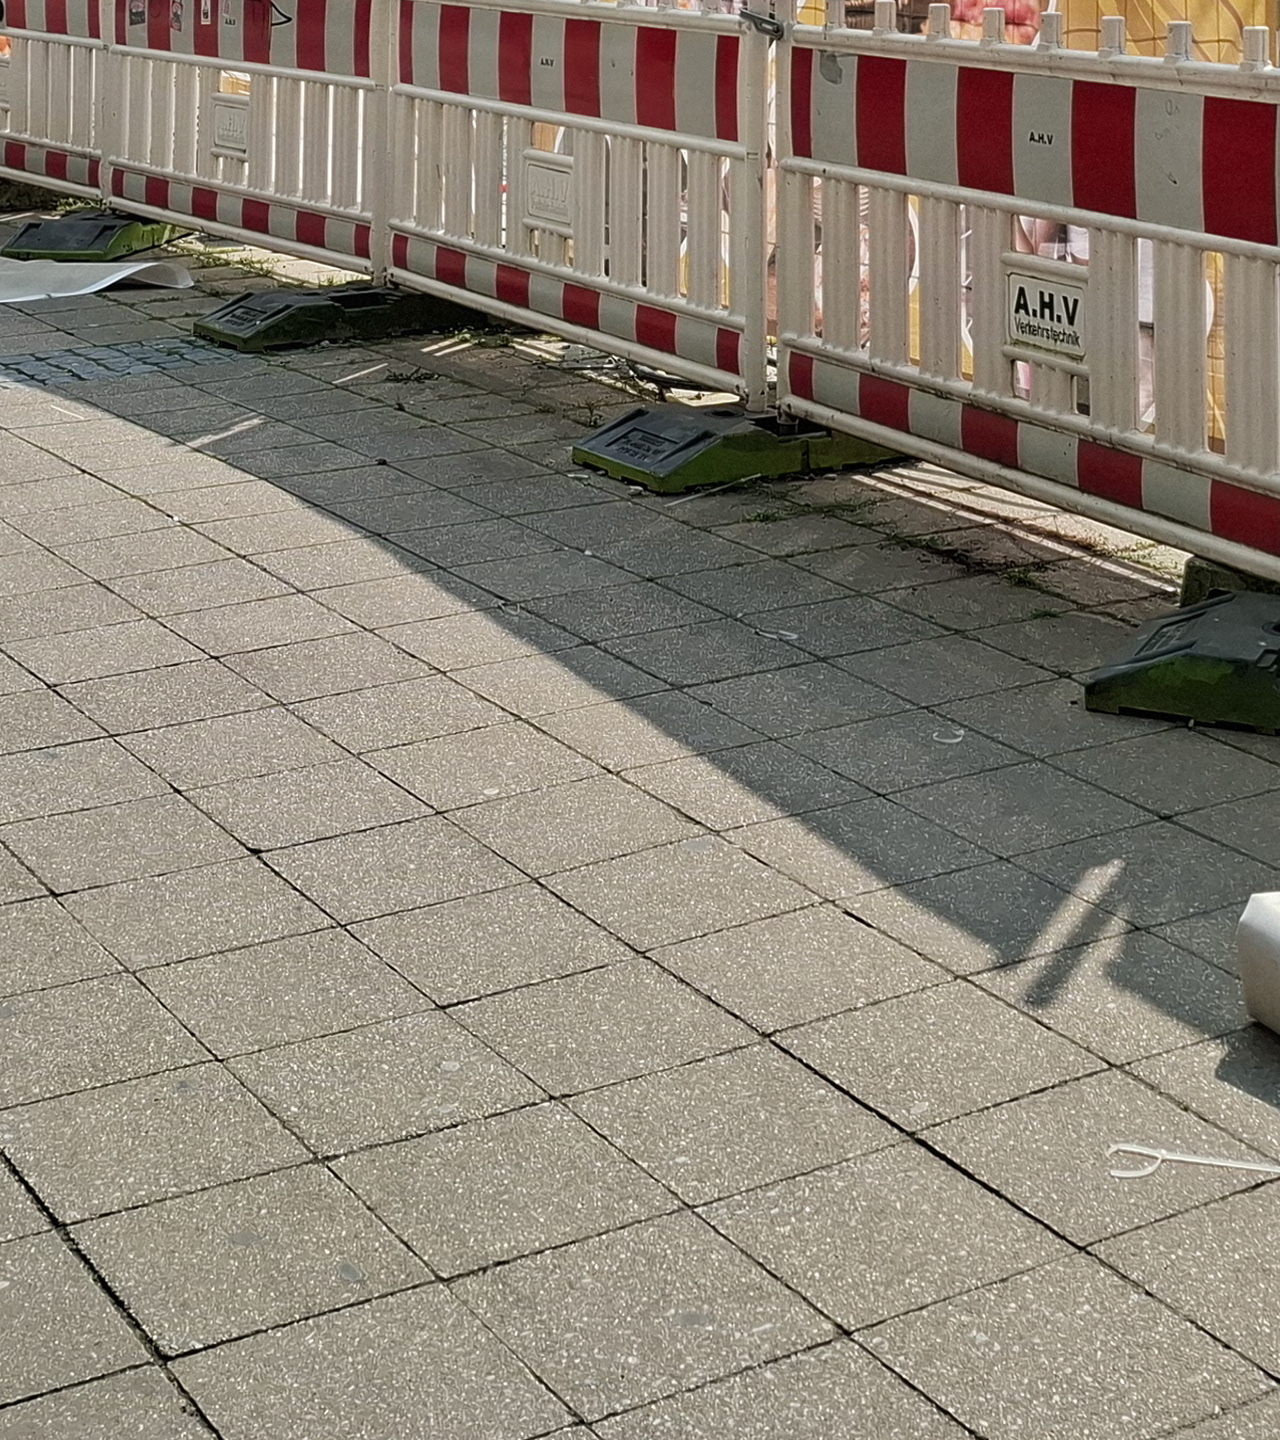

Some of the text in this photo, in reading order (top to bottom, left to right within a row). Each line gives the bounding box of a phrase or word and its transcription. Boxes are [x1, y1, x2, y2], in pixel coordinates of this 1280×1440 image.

[1029, 131, 1054, 146] A.H.V
[1014, 286, 1080, 327] A.H.V
[1014, 315, 1081, 348] Verkehrstechnik
